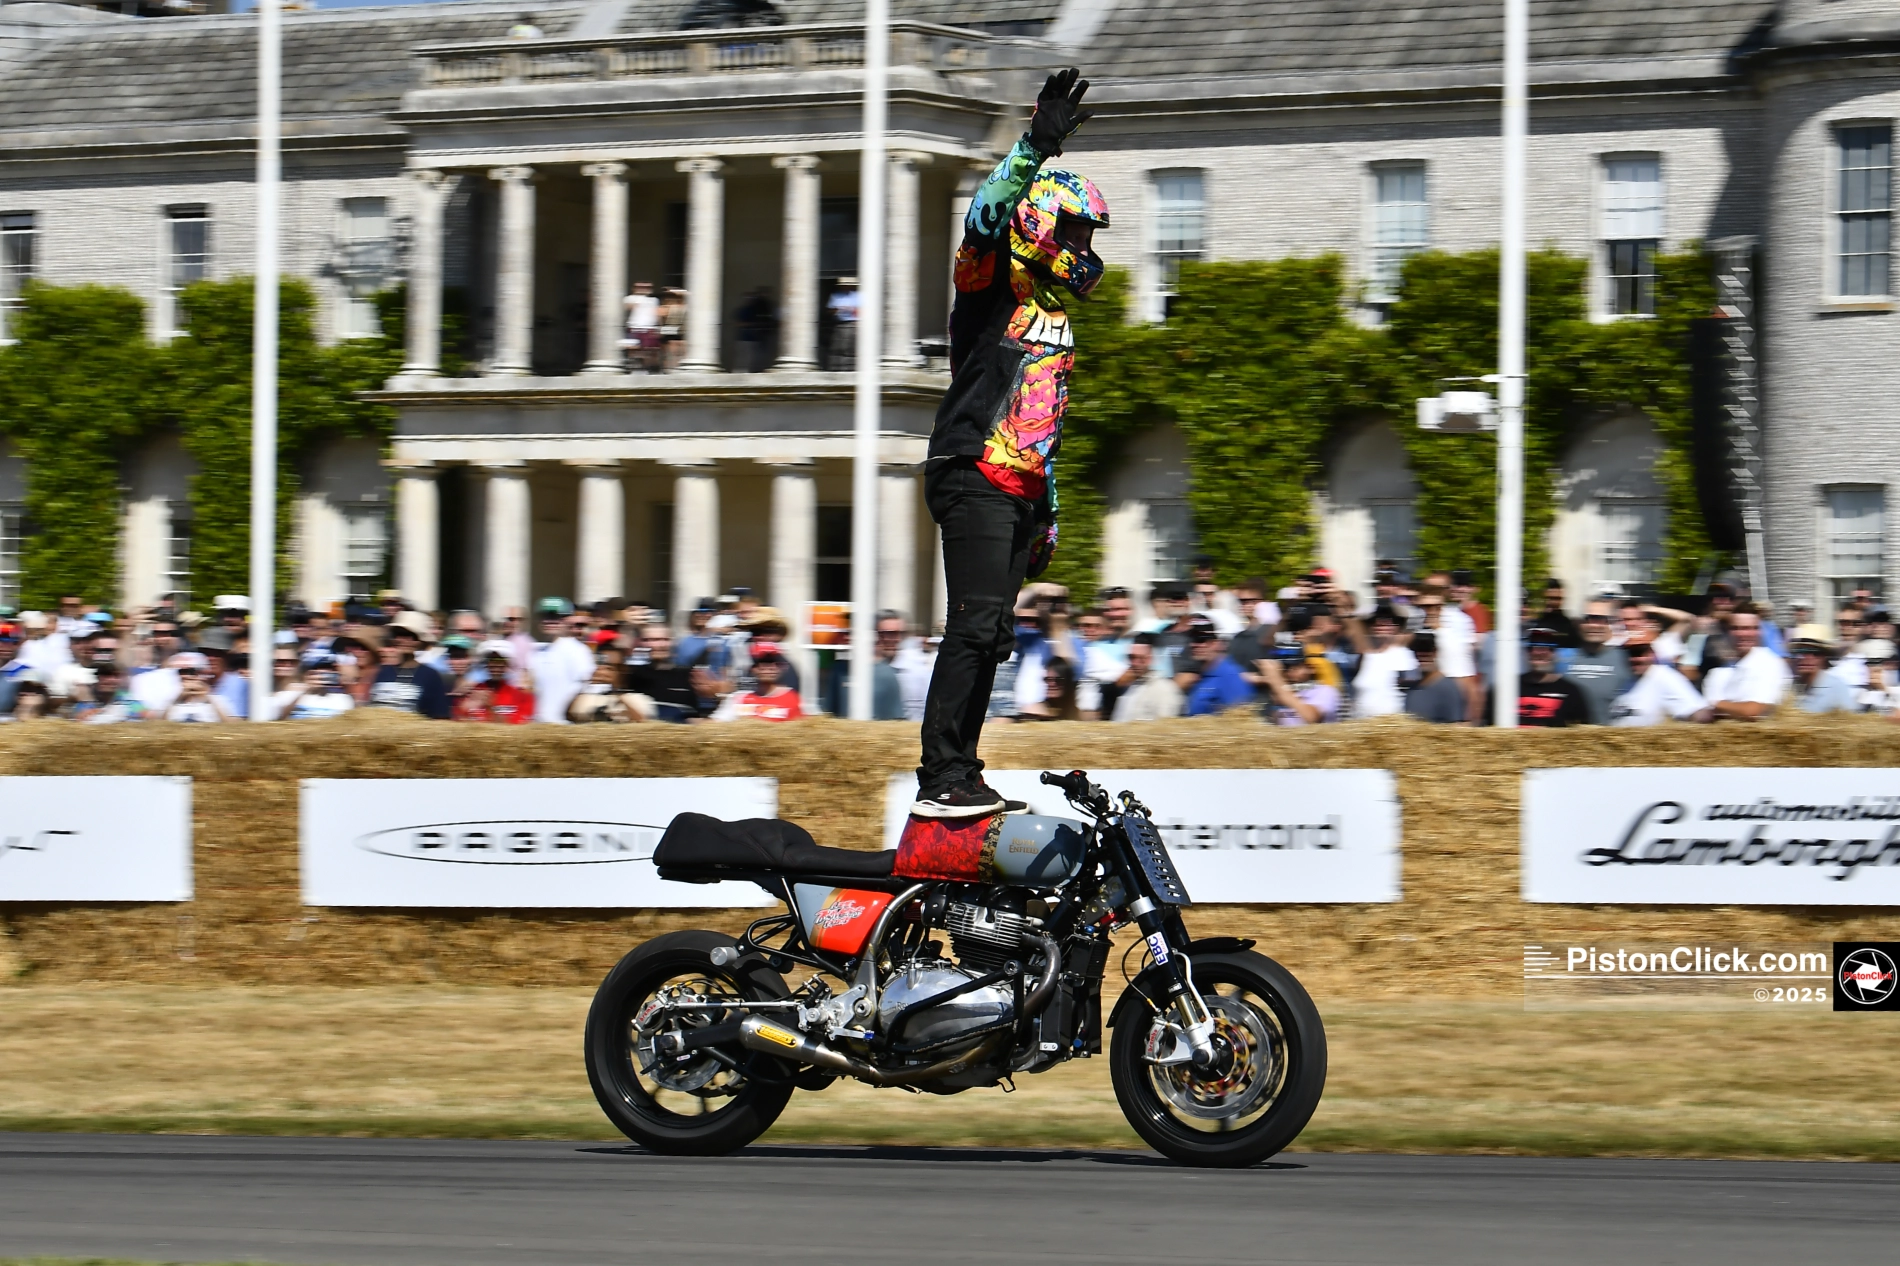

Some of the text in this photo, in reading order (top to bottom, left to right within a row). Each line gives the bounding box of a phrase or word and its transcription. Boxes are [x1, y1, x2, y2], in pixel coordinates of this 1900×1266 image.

[411, 831, 655, 853] PAGANI
[1009, 844, 1039, 855] ENFIELD
[1148, 936, 1167, 964] EBC
